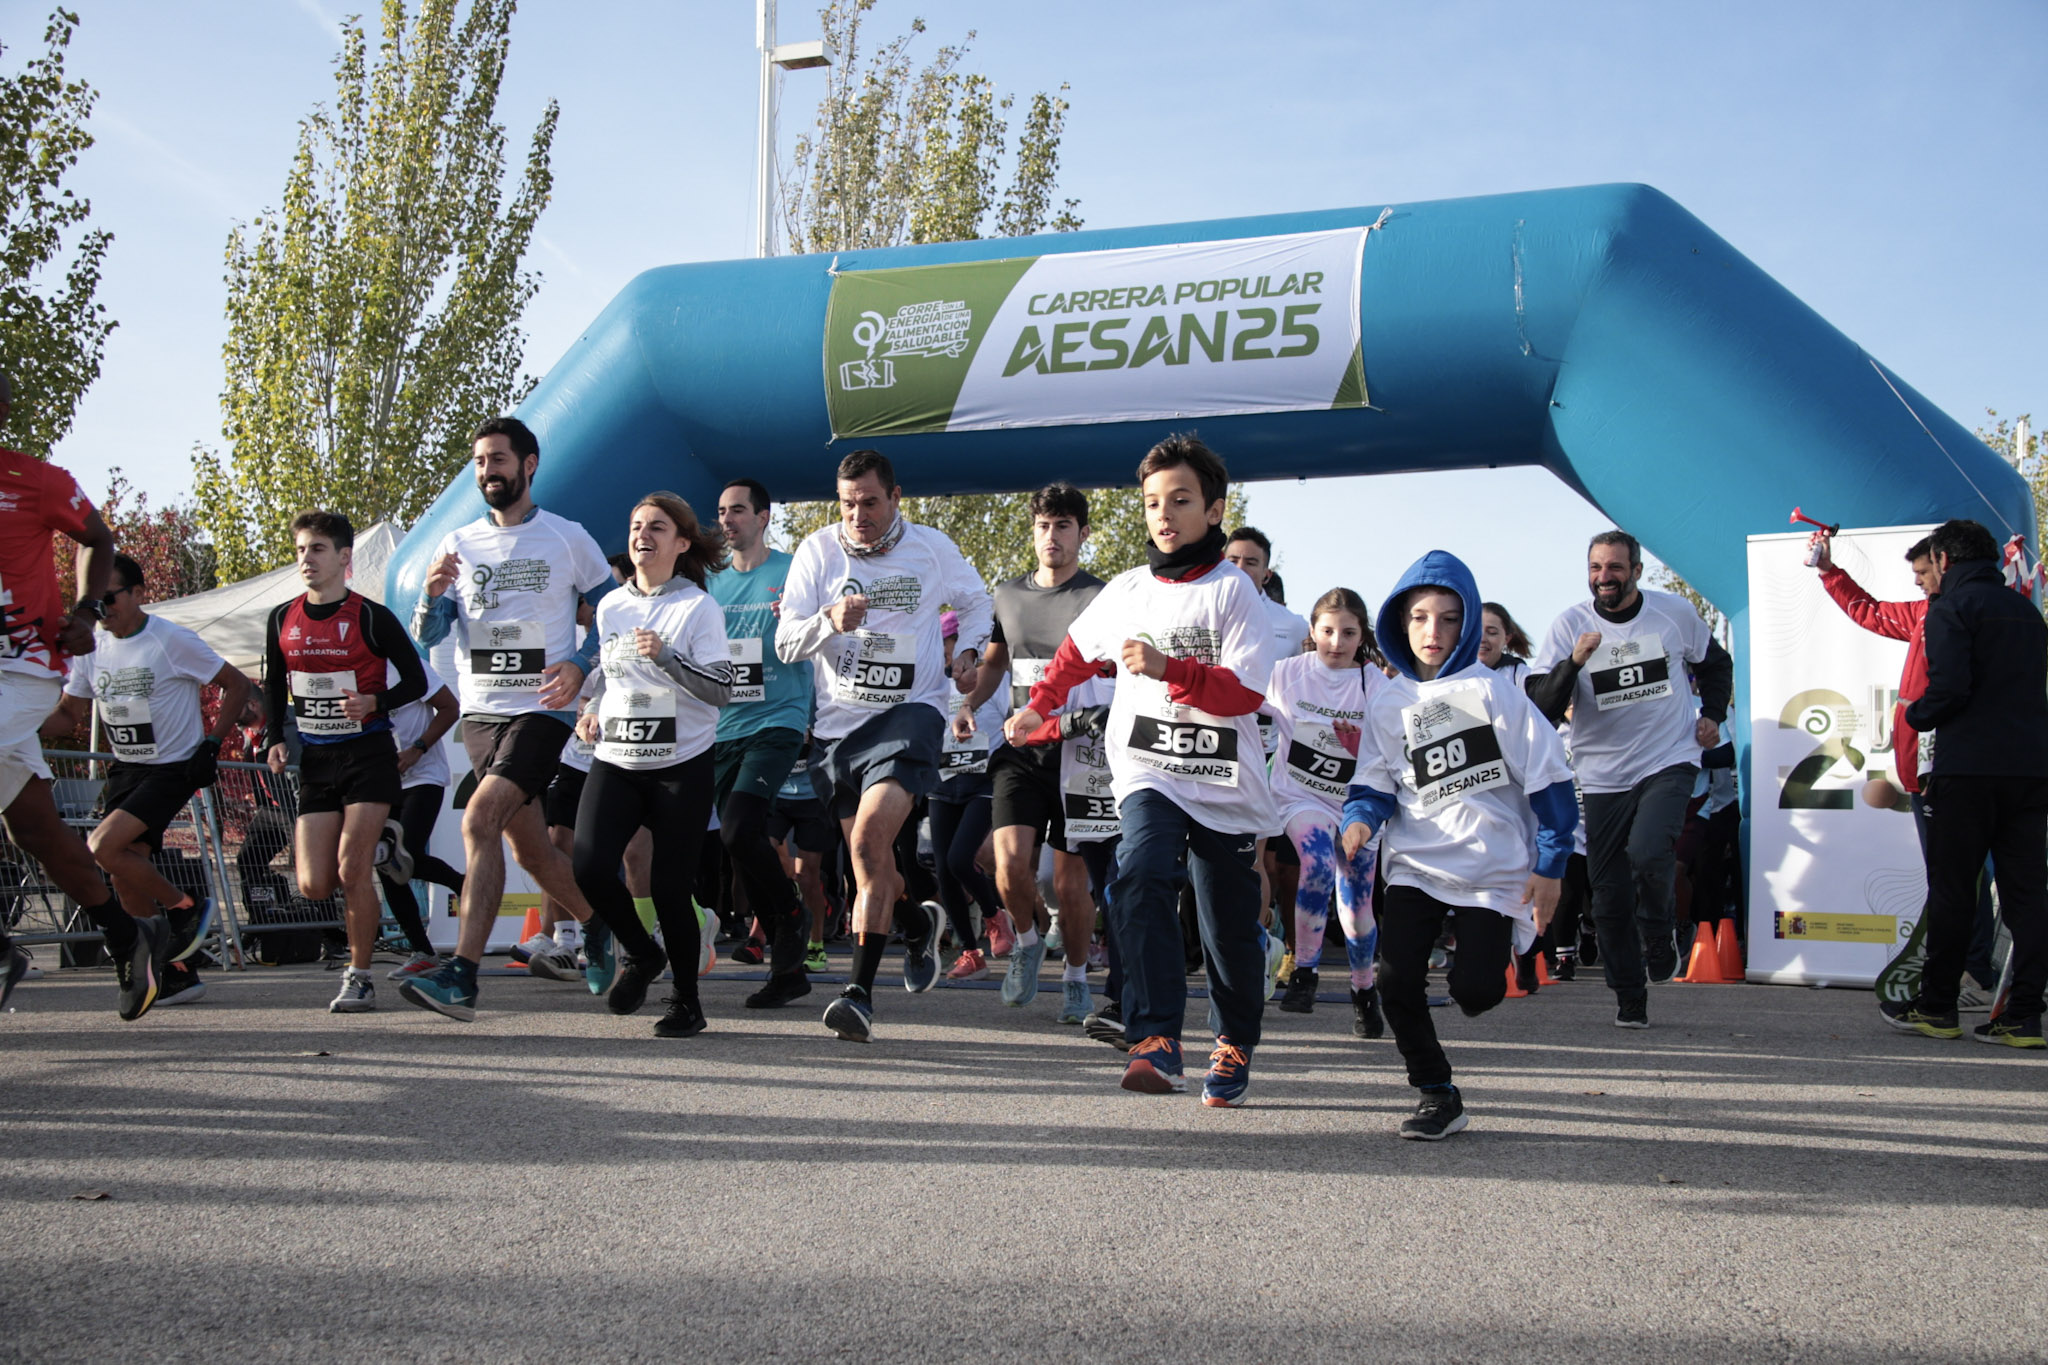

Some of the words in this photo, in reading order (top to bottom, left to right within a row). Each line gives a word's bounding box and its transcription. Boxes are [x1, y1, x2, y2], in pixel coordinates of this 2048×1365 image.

[1027, 284, 1168, 316] CARRERA
[1174, 271, 1324, 305] POPULAR
[898, 302, 941, 317] CORRE
[955, 311, 970, 320] UNA
[893, 331, 962, 351] SALUDABLE
[1001, 303, 1322, 378] AESAN25
[490, 652, 522, 672] 93
[492, 678, 542, 687] AESAN25
[855, 663, 902, 687] 500
[1618, 665, 1644, 687] 81
[859, 693, 906, 703] AESAN25
[1622, 684, 1668, 702] AESAN25
[304, 700, 345, 717] 562
[1316, 706, 1365, 720] AESAN25
[314, 721, 358, 730] AESAN25
[615, 721, 661, 741] 467
[110, 727, 138, 743] 161
[1150, 723, 1219, 754] 360
[624, 748, 672, 757] AESAN25
[949, 752, 973, 766] 32
[1425, 738, 1467, 777] 80
[1163, 763, 1232, 778] AESAN25
[1308, 753, 1341, 778] 79
[1440, 767, 1501, 799] AESAN25
